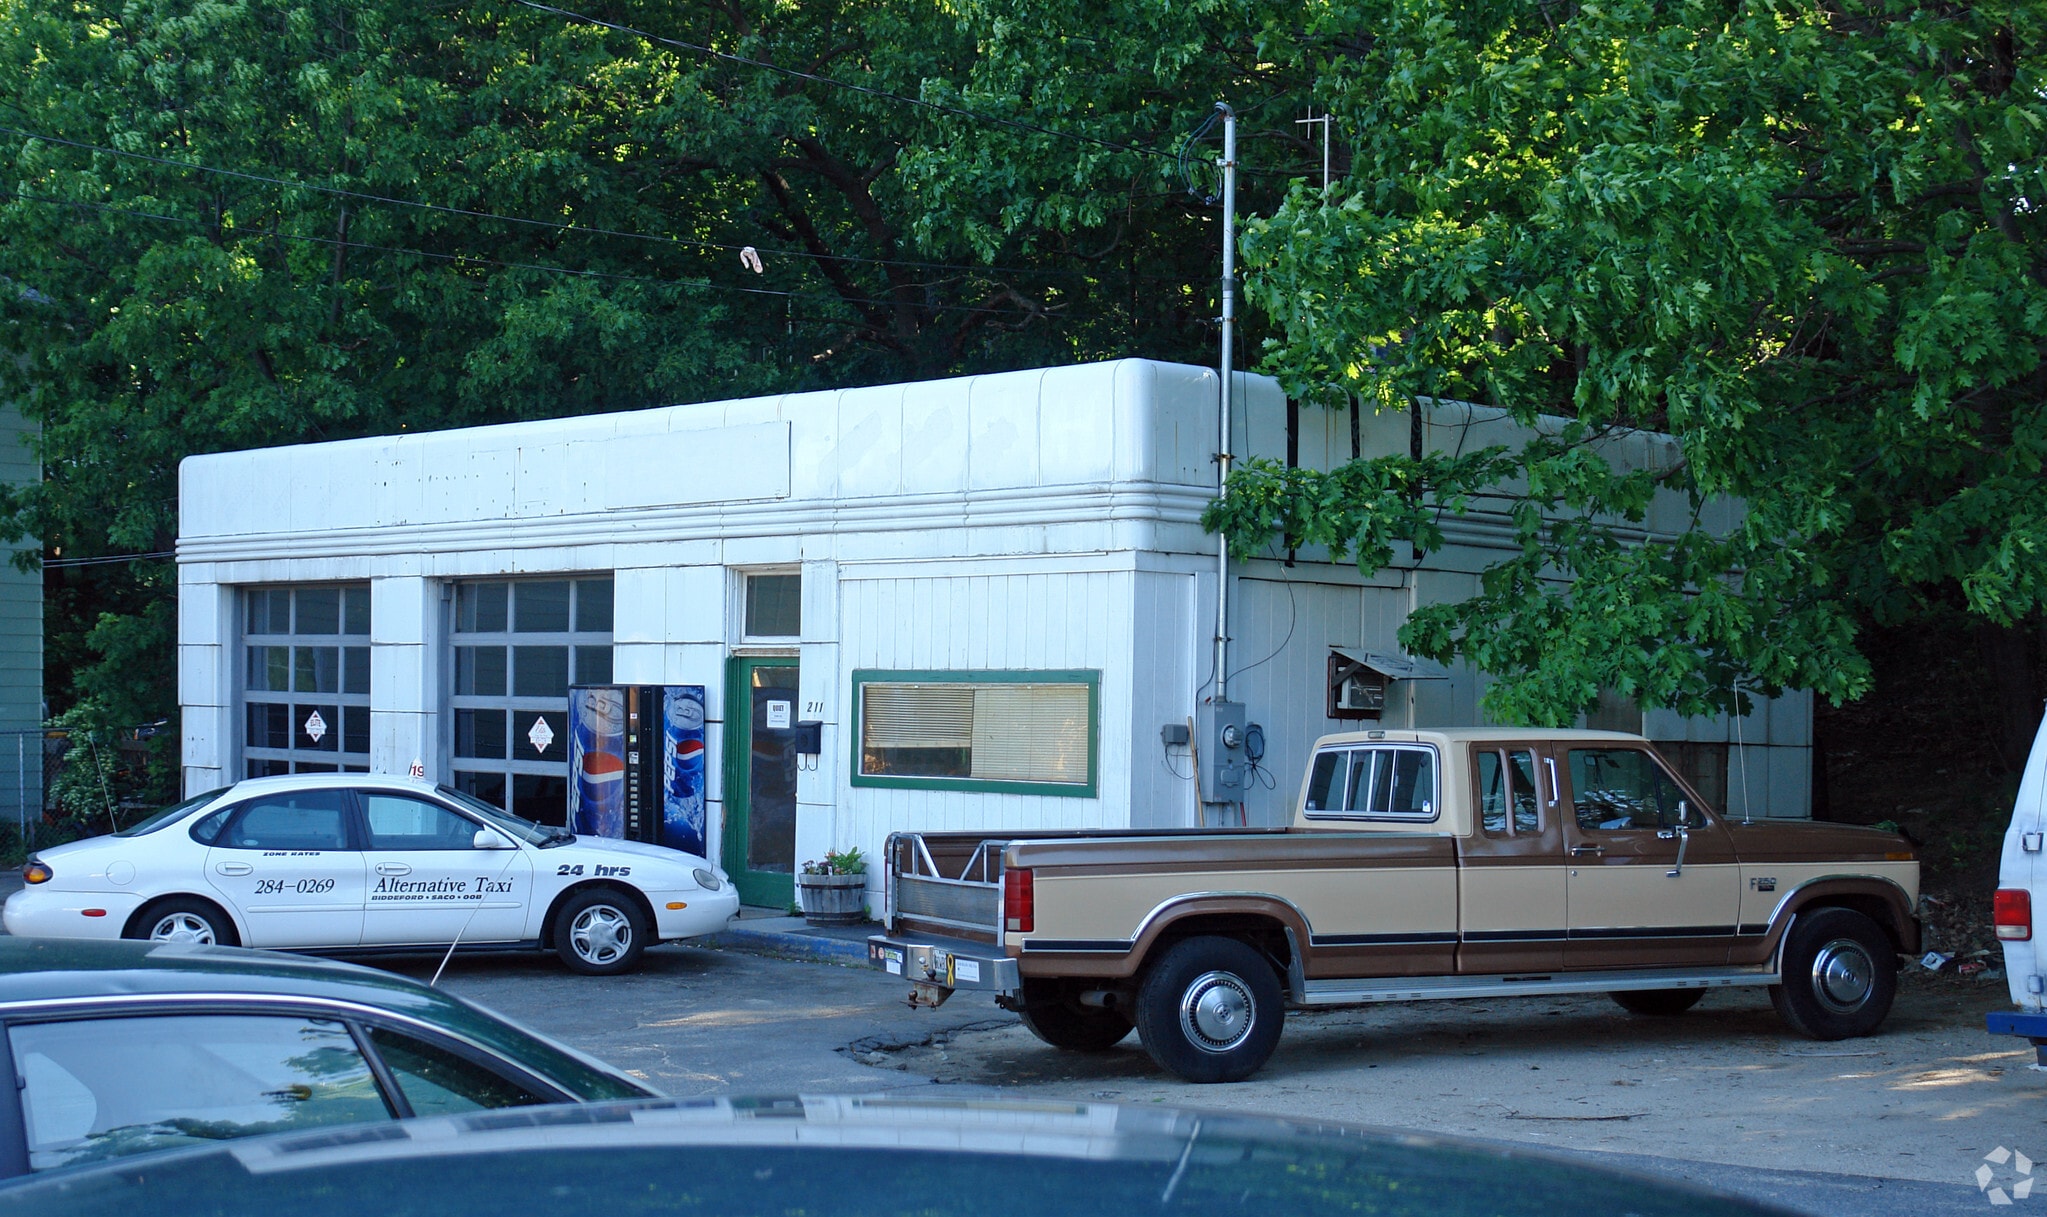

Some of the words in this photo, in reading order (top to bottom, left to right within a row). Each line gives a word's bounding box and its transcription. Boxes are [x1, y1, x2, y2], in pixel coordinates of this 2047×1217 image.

[807, 701, 823, 713] 211
[664, 730, 678, 794] PEPSI
[556, 864, 584, 876] 24
[594, 864, 631, 876] hrs
[254, 879, 335, 894] 284-0269
[373, 877, 467, 893] Alternative
[475, 877, 514, 893] Taxi
